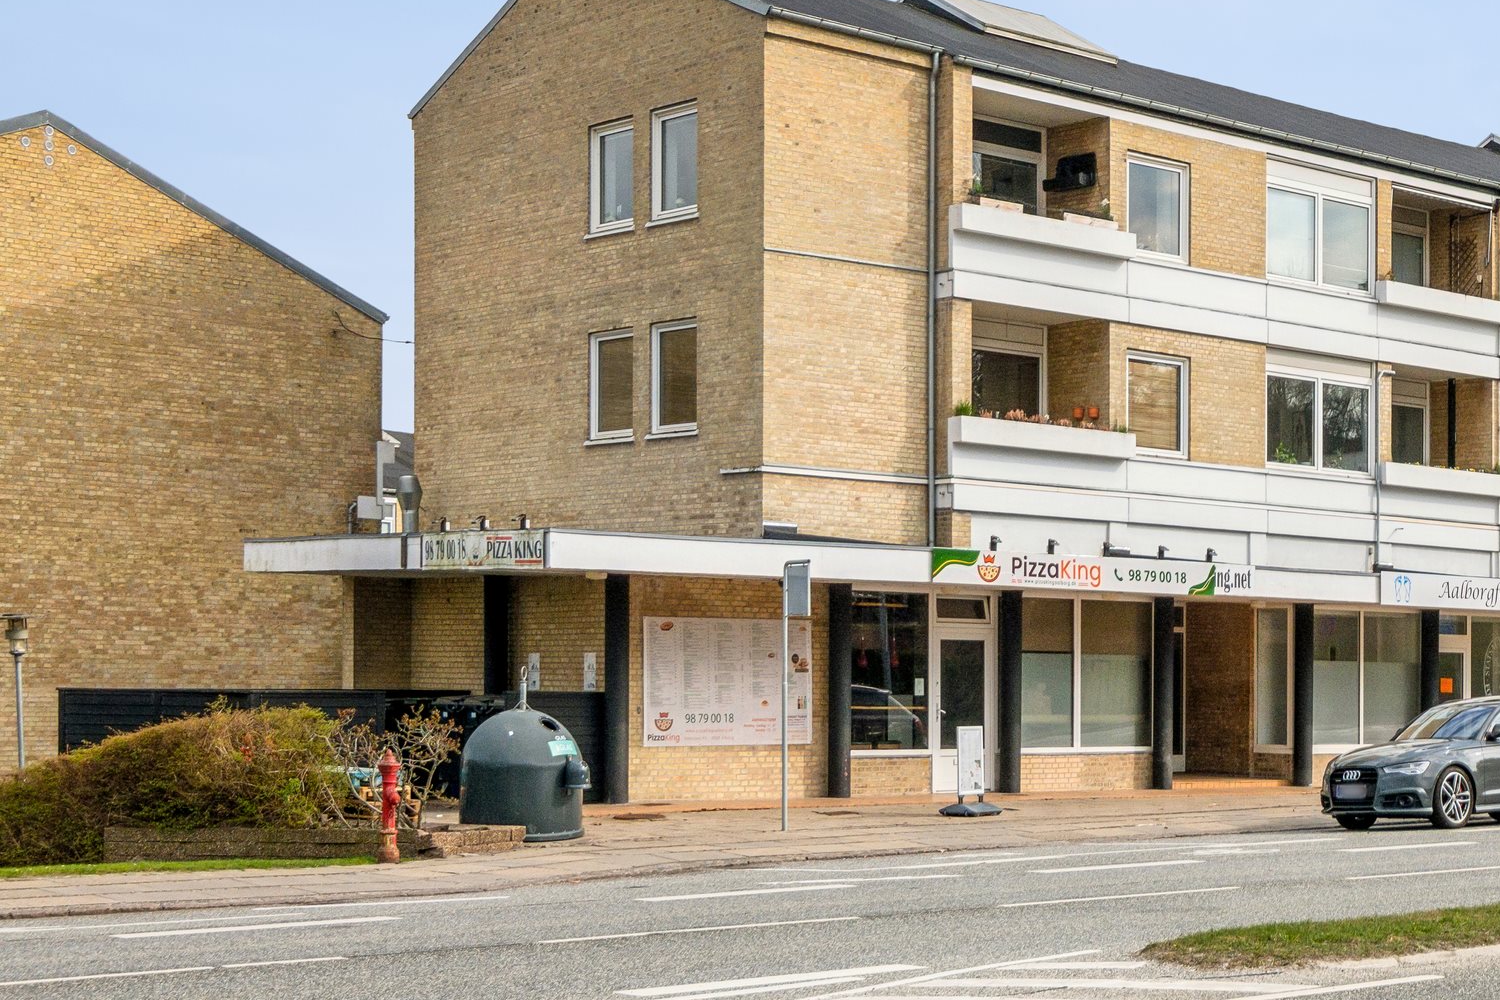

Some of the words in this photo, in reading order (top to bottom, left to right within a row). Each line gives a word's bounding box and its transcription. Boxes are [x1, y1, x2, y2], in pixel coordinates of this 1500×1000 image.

[425, 540, 434, 560] 98
[436, 540, 445, 560] 79
[446, 539, 456, 559] 00
[458, 538, 466, 559] 18
[486, 540, 512, 559] PIZZA
[514, 540, 542, 559] KING
[1011, 555, 1101, 588] PizzaKing
[1128, 569, 1142, 582] 98
[1144, 570, 1157, 583] 79
[1159, 571, 1172, 584] 00
[1175, 571, 1187, 584] 18
[684, 713, 696, 724] 98
[699, 713, 709, 724] 79
[710, 713, 722, 724] 00
[724, 713, 735, 724] 18
[647, 733, 681, 744] PizzaKing
